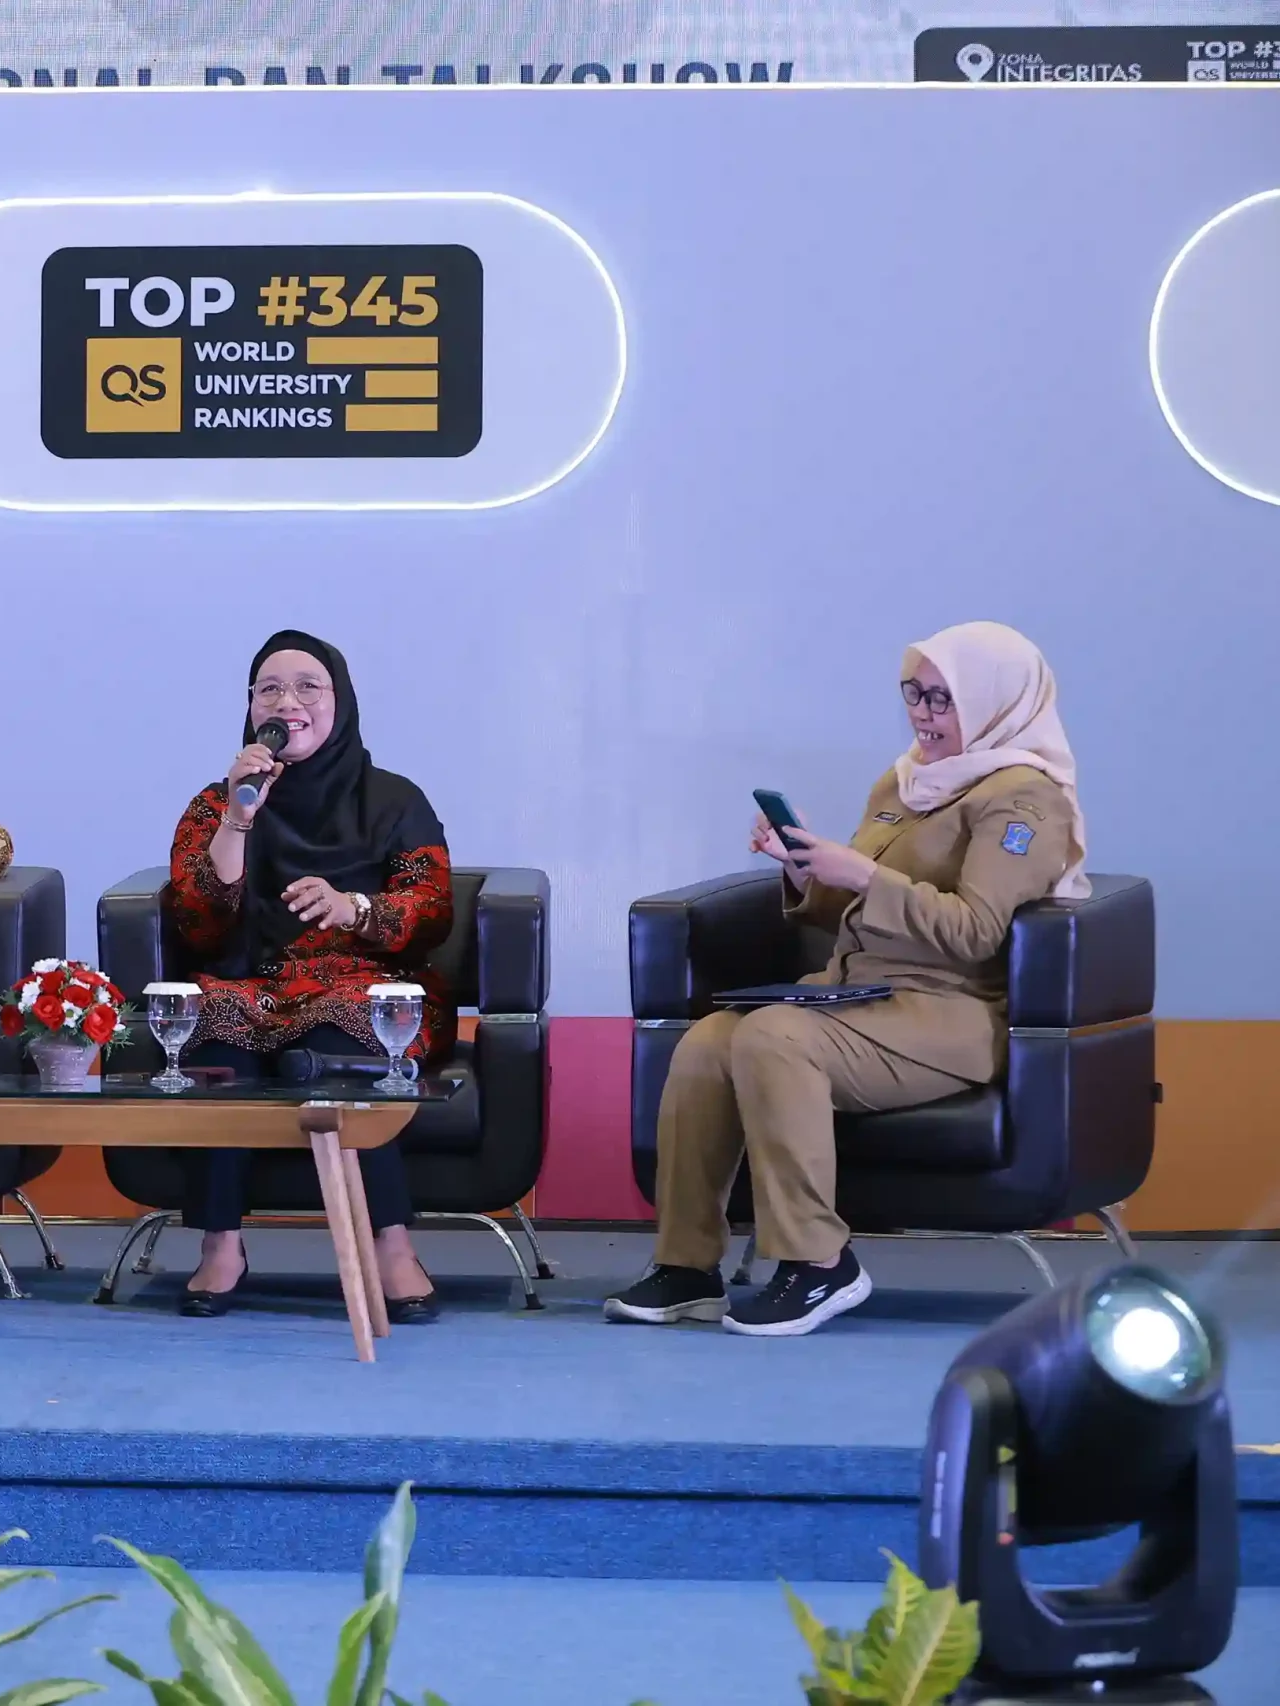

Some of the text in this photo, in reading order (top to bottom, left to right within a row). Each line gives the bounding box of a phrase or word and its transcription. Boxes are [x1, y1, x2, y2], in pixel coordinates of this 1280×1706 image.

[997, 53, 1045, 65] ZONA
[1186, 41, 1246, 59] TOP
[996, 62, 1143, 83] INTEGRITAS
[84, 274, 439, 328] TOP #345
[193, 340, 296, 362] WORLD
[100, 363, 167, 408] QS
[193, 373, 352, 396] UNIVERSITY
[193, 406, 333, 429] RANKINGS
